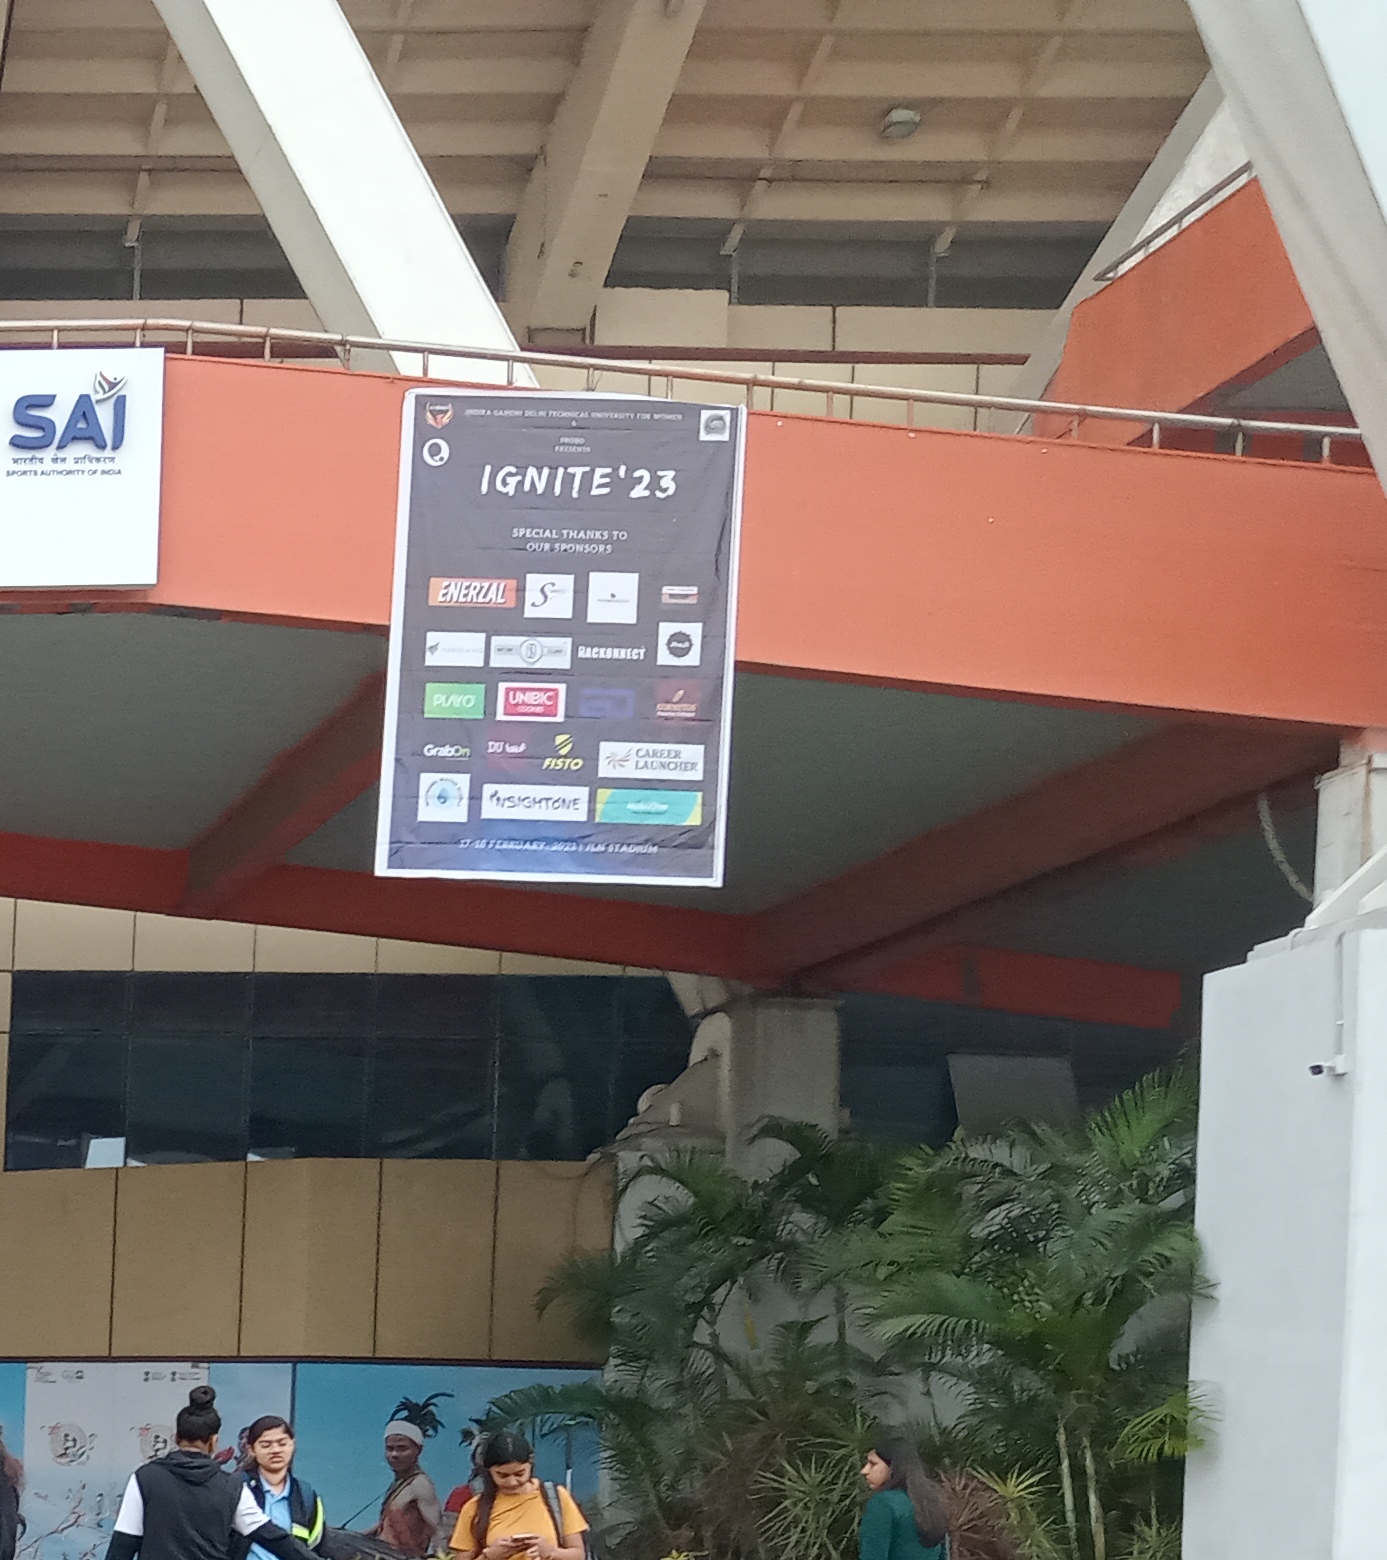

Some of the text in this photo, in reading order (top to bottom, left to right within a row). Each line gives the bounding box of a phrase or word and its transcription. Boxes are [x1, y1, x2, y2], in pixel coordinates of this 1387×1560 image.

[8, 393, 127, 450] SAI
[6, 469, 38, 477] SPORTS
[40, 469, 85, 477] AUTHORITY
[100, 468, 123, 476] INDIA
[480, 464, 677, 499] IGNITE'23
[512, 527, 628, 541] SPECIAL THANKS TO
[526, 542, 613, 555] OUR SPONSORS
[436, 580, 507, 604] ENERZAL
[508, 690, 555, 705] UNIBIC
[423, 743, 472, 757] GrabOn
[634, 747, 682, 760] CAREER
[542, 757, 584, 772] FISTO
[634, 760, 699, 772] LAUNCHER
